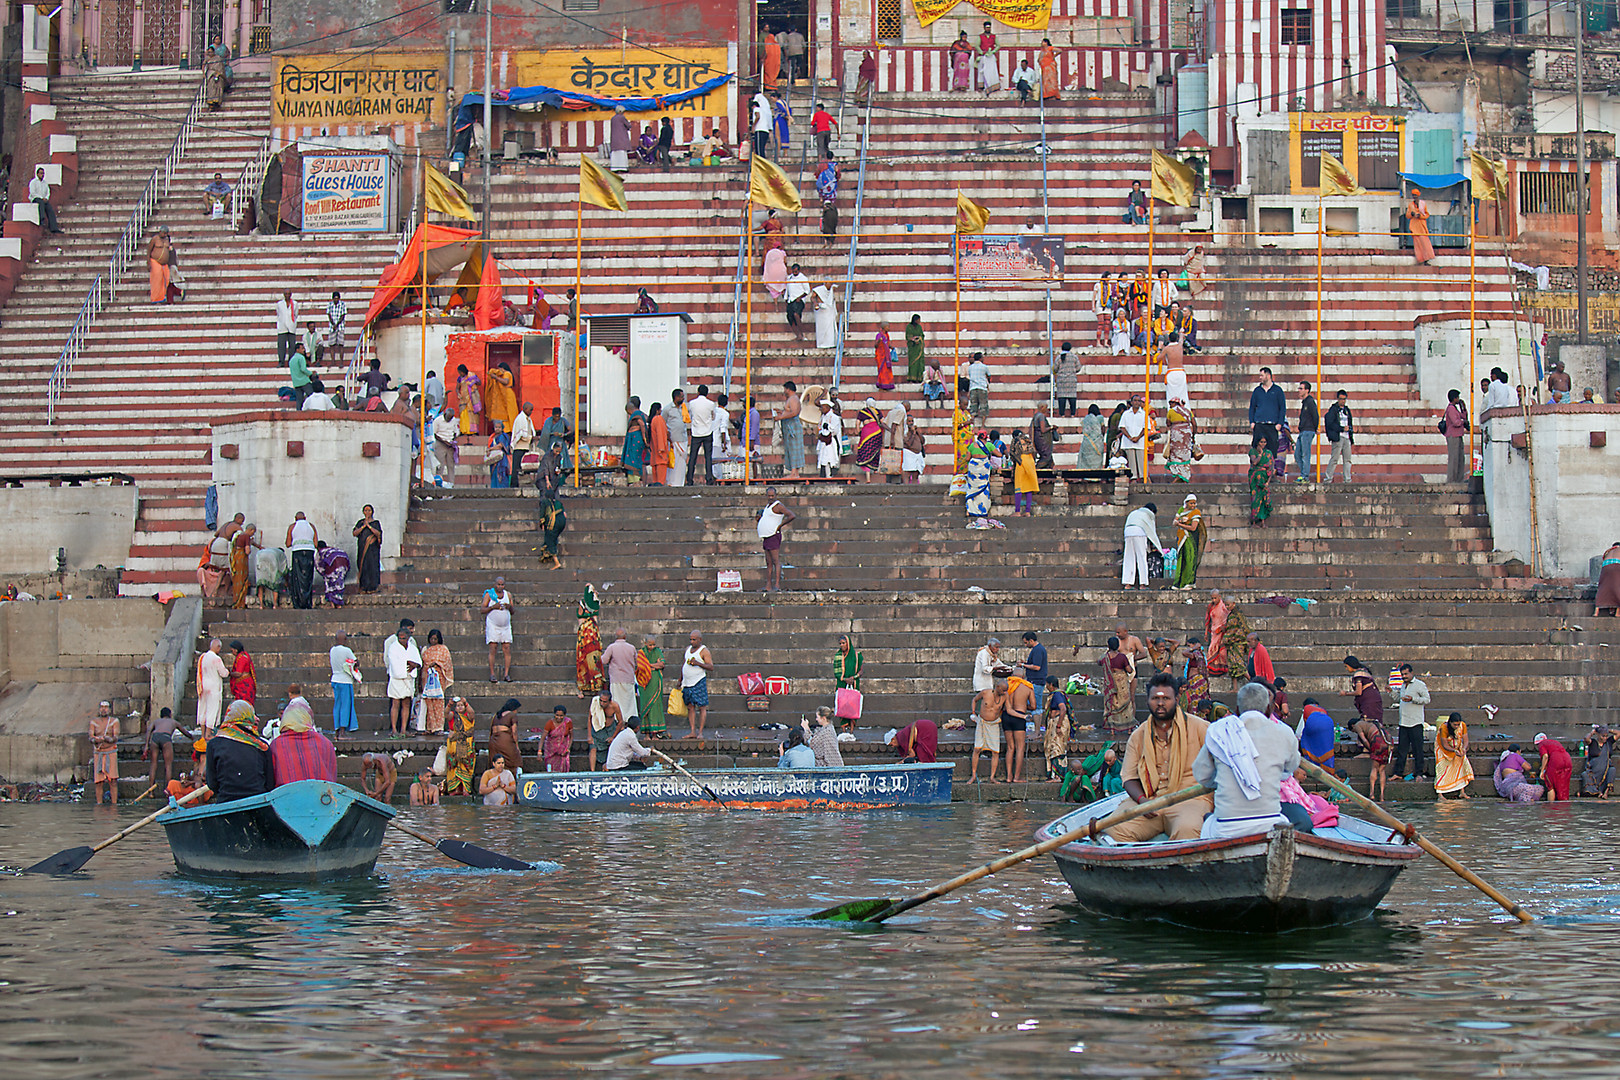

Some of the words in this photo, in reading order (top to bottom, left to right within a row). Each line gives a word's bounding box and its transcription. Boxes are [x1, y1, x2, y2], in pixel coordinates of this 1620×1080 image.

[401, 69, 439, 92] घाट
[571, 56, 660, 90] केदार
[663, 63, 711, 88] घाट
[277, 98, 391, 117] VIJAYANAGARAM
[395, 97, 434, 114] GHAT
[1352, 116, 1389, 131] पीठ
[310, 158, 380, 174] SHANTI
[306, 175, 346, 190] Guest
[346, 174, 384, 189] House
[331, 195, 381, 212] Restaurant
[552, 780, 591, 802] सुलभ
[820, 773, 871, 797] वाराणसी
